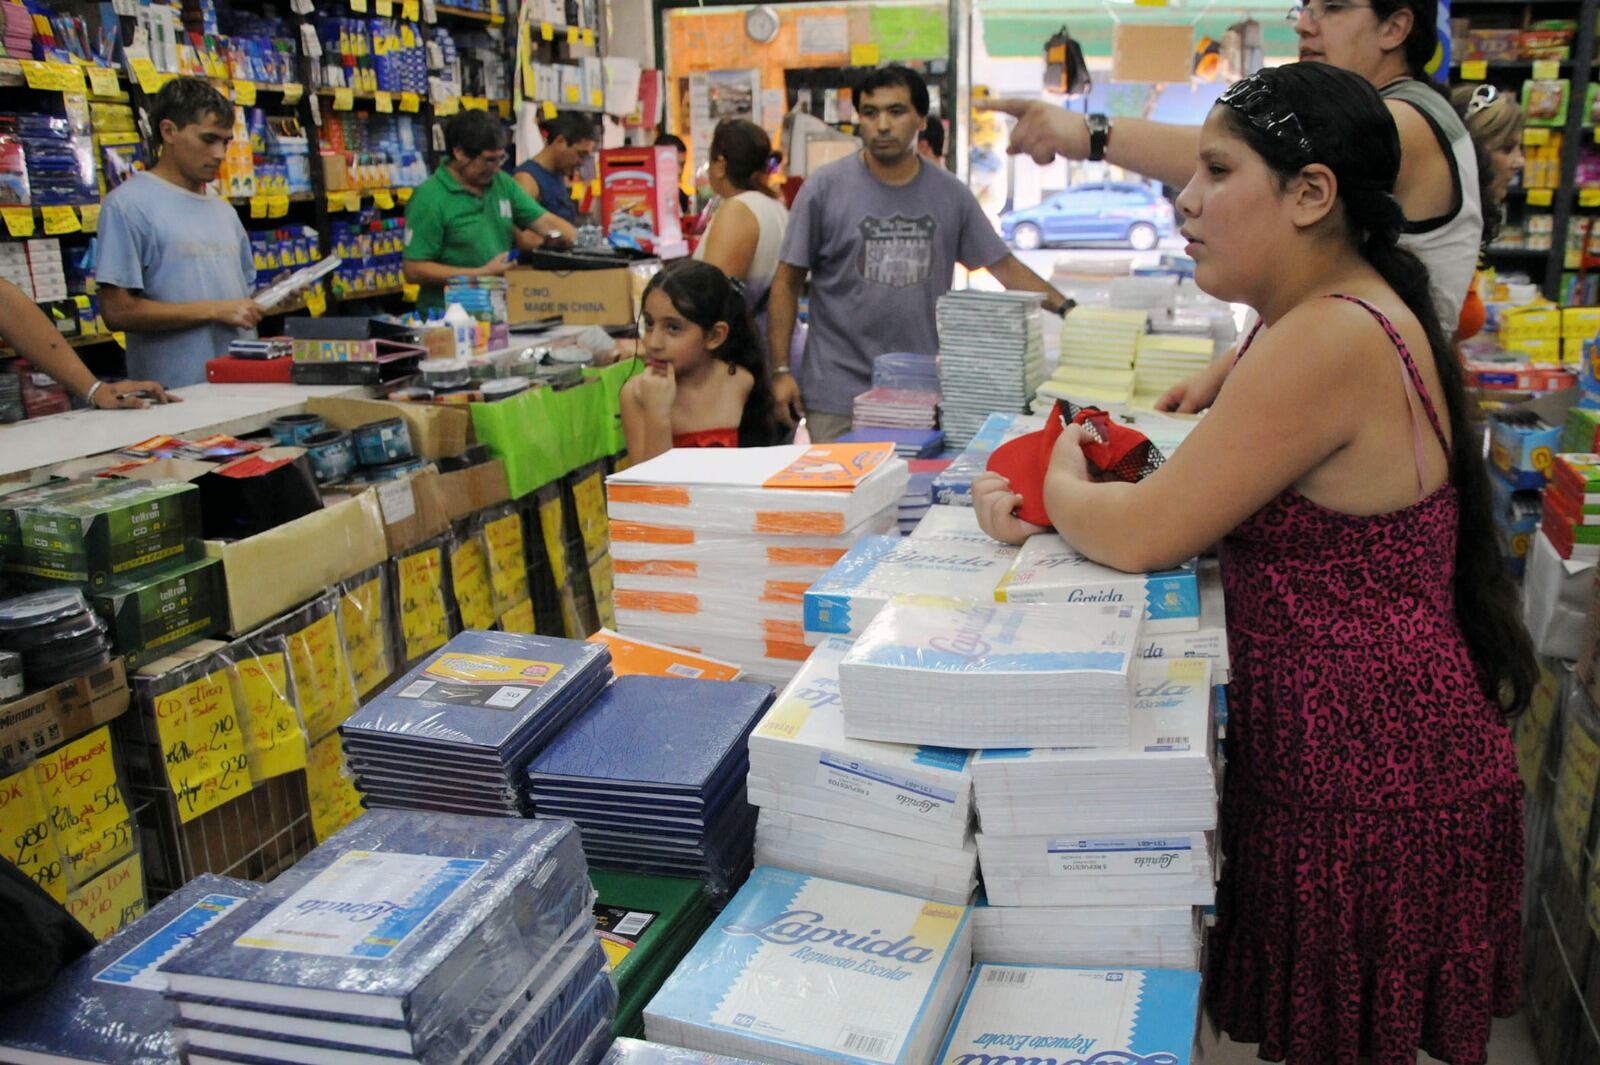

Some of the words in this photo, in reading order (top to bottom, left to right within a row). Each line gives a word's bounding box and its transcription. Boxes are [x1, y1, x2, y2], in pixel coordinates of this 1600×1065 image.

[524, 302, 554, 313] MADE
[557, 302, 568, 313] IN
[895, 793, 940, 814] Laprida
[721, 910, 935, 964] Laprida
[789, 944, 857, 970] Repuesto
[852, 958, 913, 982] Escolar
[972, 1032, 1028, 1051] Escolar
[1029, 1035, 1097, 1055] Repuesto
